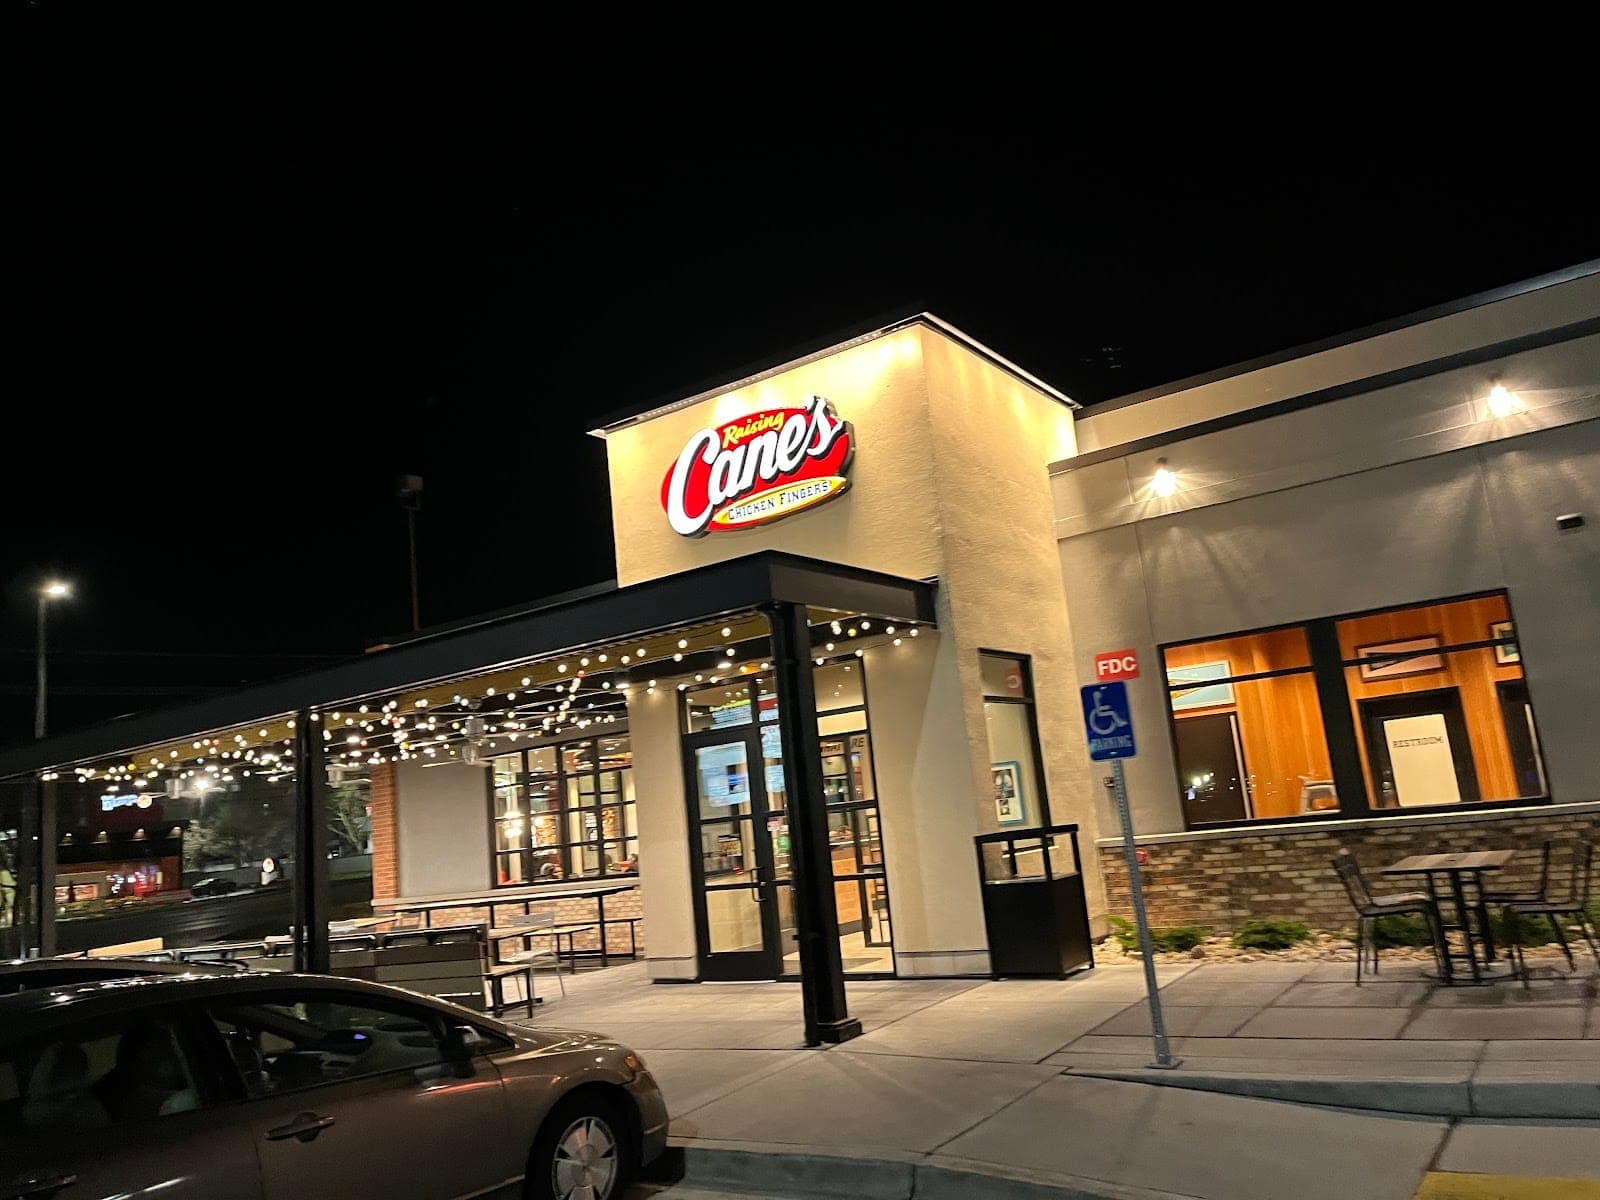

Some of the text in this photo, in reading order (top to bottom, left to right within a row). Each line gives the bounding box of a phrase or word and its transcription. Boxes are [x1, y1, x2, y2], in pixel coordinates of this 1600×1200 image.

[722, 411, 785, 448] Raising
[667, 395, 844, 536] Cane's
[728, 481, 829, 520] CHICKEN FINGERS
[1097, 656, 1137, 676] FDC
